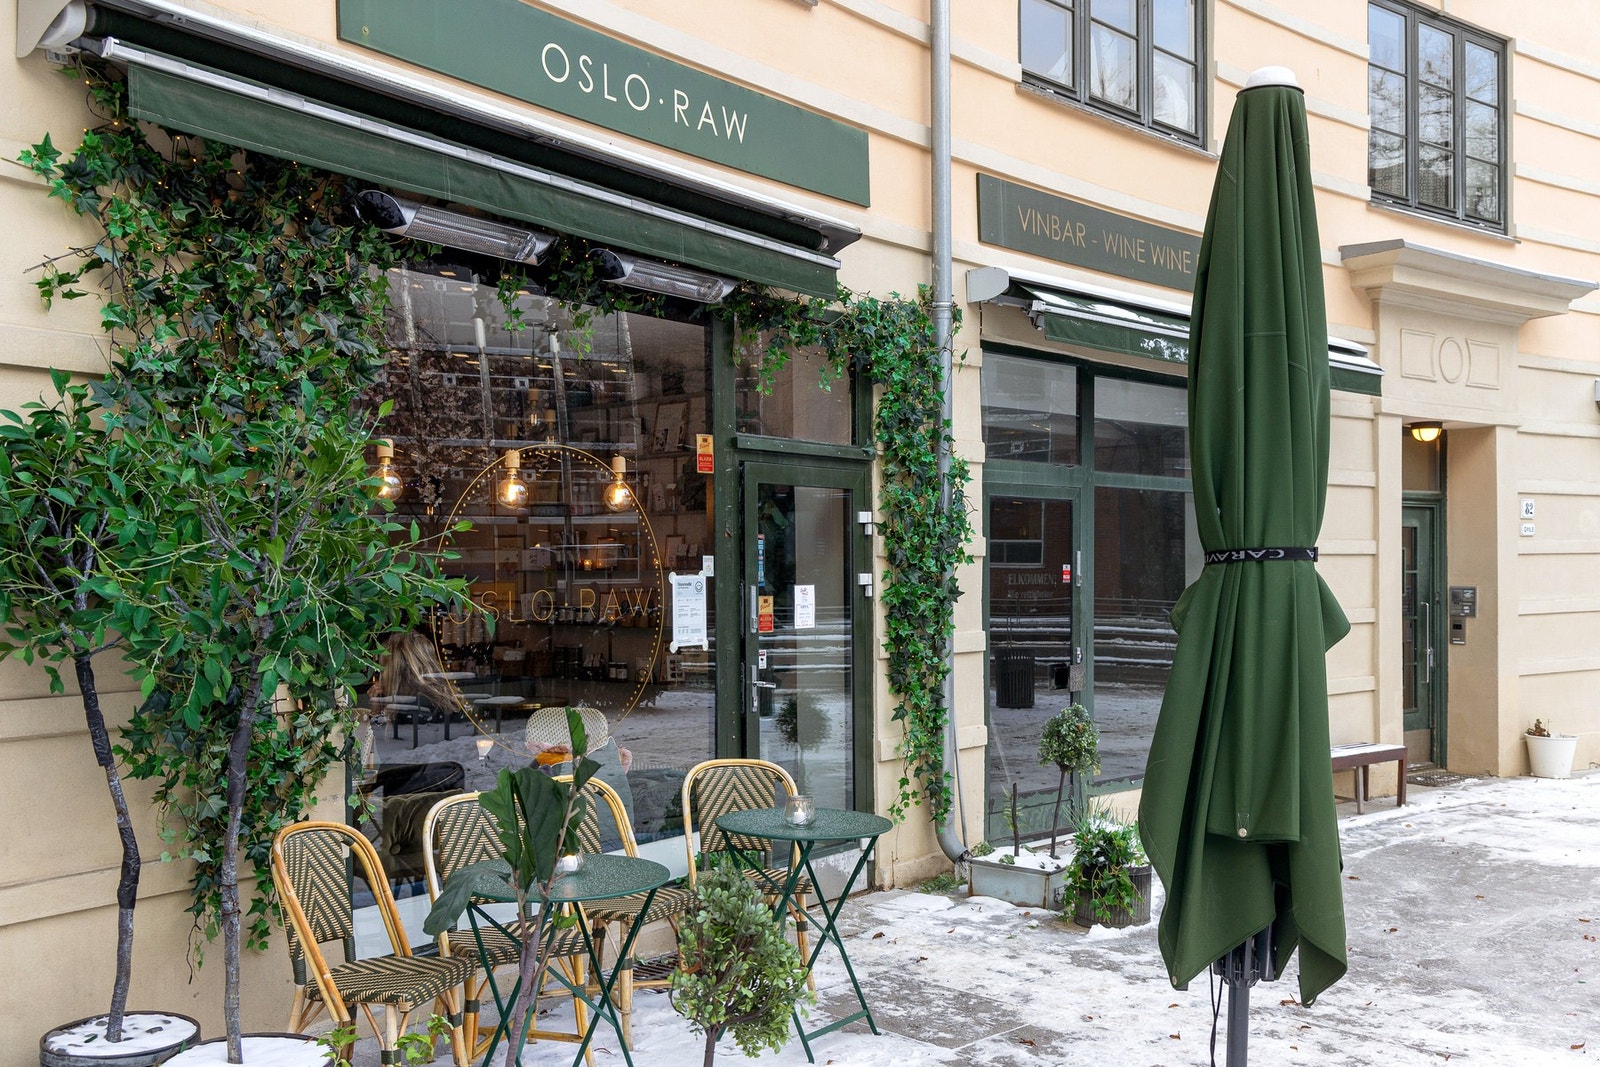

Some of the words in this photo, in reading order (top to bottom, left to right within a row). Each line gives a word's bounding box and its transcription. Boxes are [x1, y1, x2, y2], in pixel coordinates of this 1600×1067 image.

[541, 42, 651, 111] OSLO
[673, 88, 748, 144] RAW
[1017, 205, 1086, 249] VINBAR
[1102, 229, 1146, 264] WINE
[1150, 241, 1192, 275] WINE
[1525, 502, 1534, 515] 82
[580, 588, 653, 619] RAW
